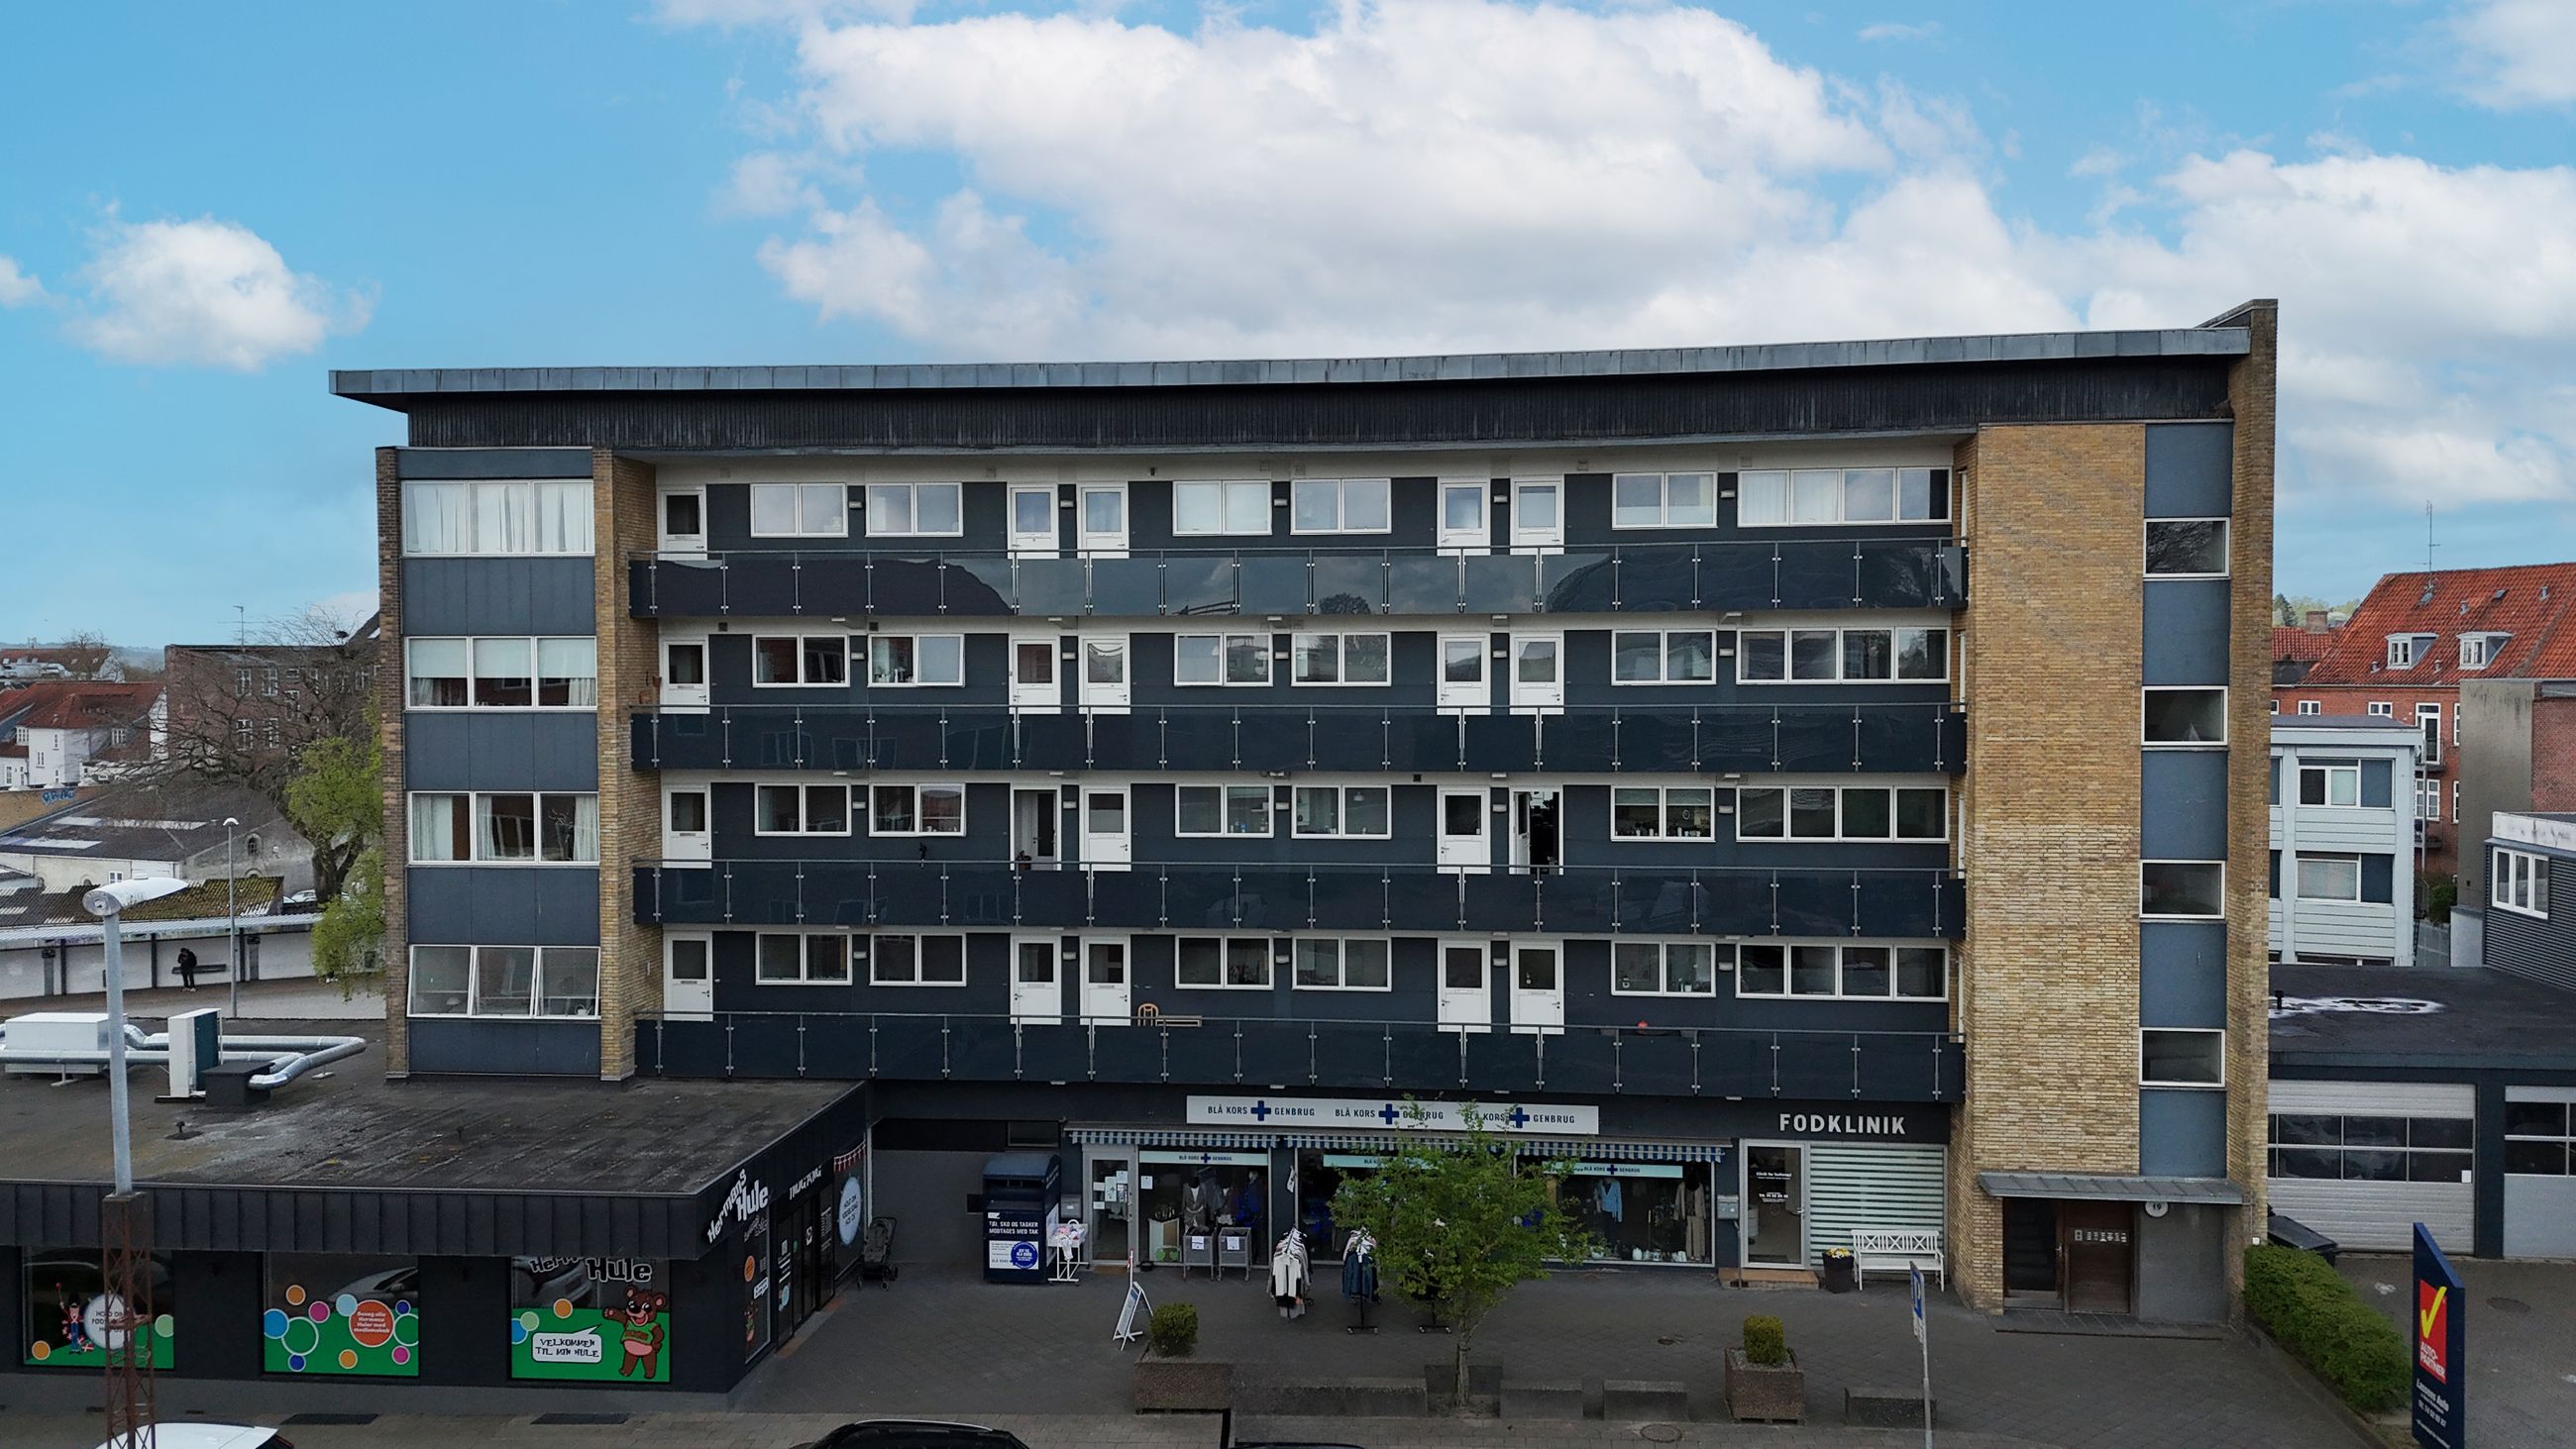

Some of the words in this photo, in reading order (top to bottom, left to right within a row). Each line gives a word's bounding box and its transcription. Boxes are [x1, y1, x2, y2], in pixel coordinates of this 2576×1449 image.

[1207, 1103, 1224, 1114] BLÅ
[1226, 1105, 1248, 1115] KORS
[1274, 1107, 1316, 1116] GENBRUG
[1335, 1107, 1350, 1117] BLÅ
[1353, 1109, 1376, 1118] KORS
[1533, 1114, 1575, 1124] GENBRUG
[1779, 1113, 1906, 1134] FODKLINIK
[706, 1168, 747, 1244] Hermans
[735, 1179, 769, 1222] Hule
[585, 1257, 652, 1283] Hule
[540, 1338, 595, 1347] VELKOMMEN
[535, 1346, 553, 1356] TIL
[556, 1347, 571, 1356] MIN
[574, 1348, 599, 1358] HULE
[2420, 1351, 2446, 1380] PARTNER
